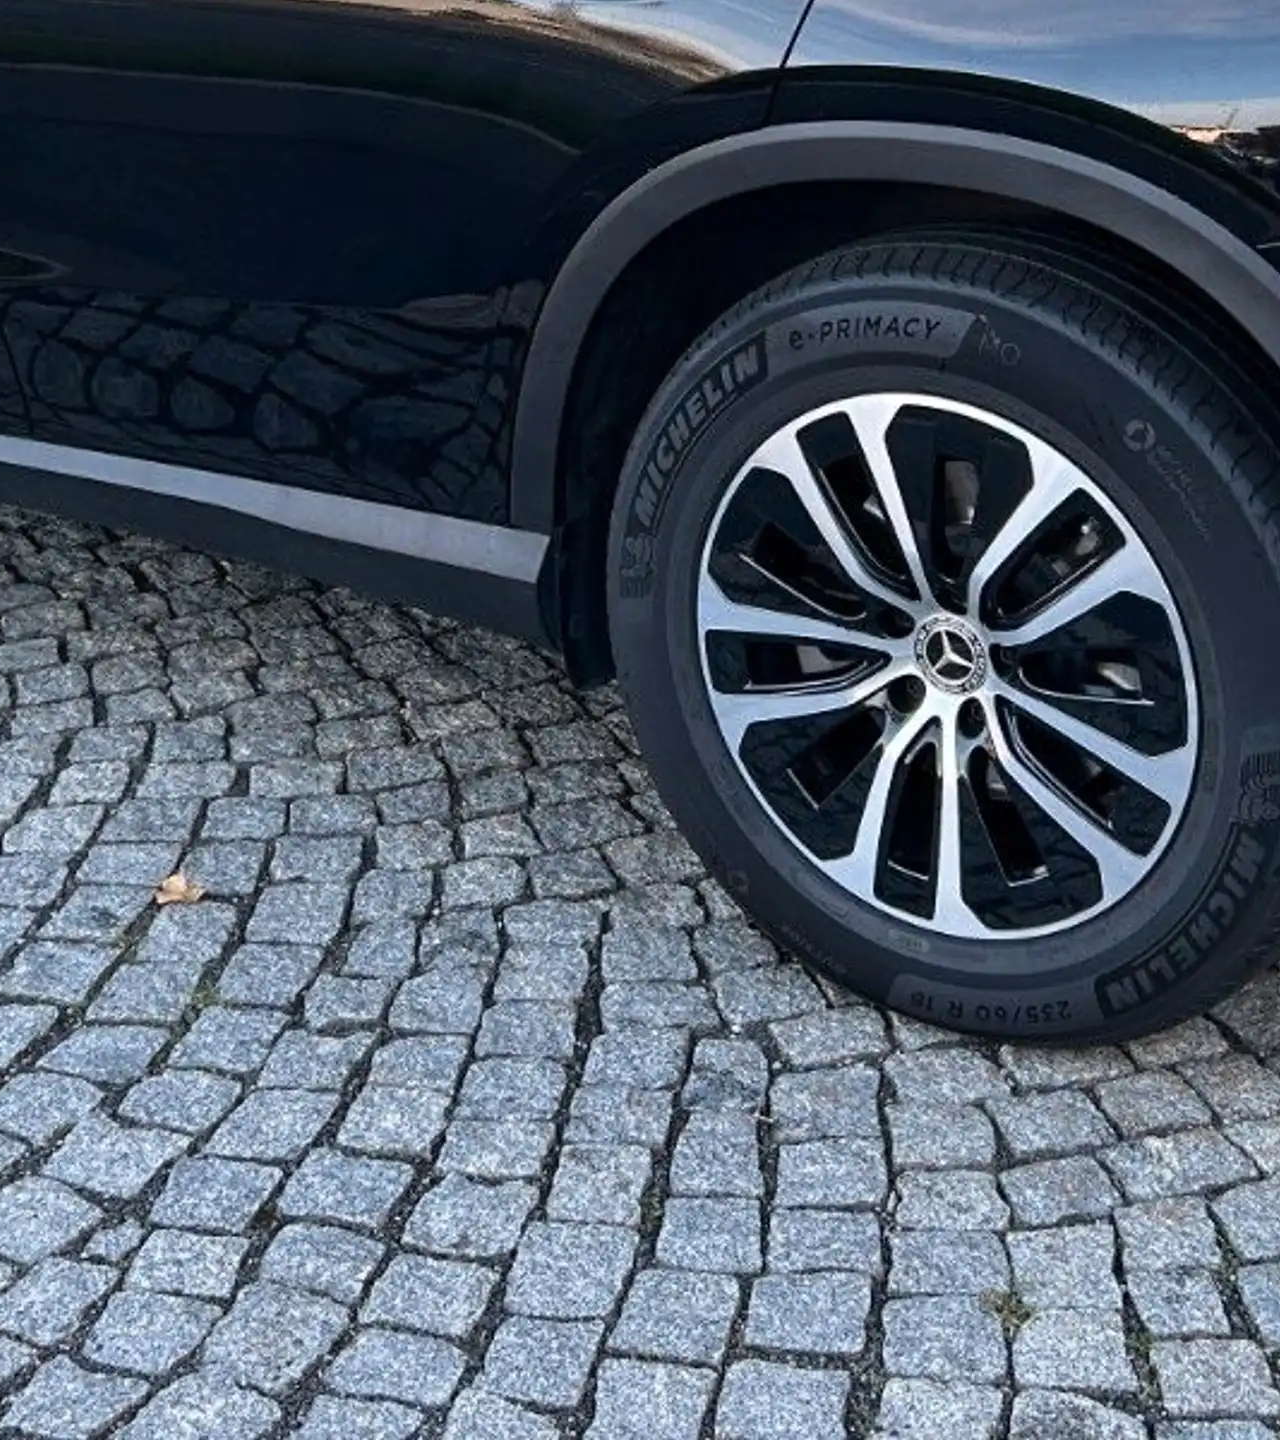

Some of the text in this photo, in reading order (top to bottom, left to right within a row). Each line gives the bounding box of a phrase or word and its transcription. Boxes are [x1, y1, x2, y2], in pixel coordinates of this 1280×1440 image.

[633, 343, 760, 528] MICHELIN
[948, 1000, 965, 1020] R
[1103, 832, 1266, 1011] MICHELIN
